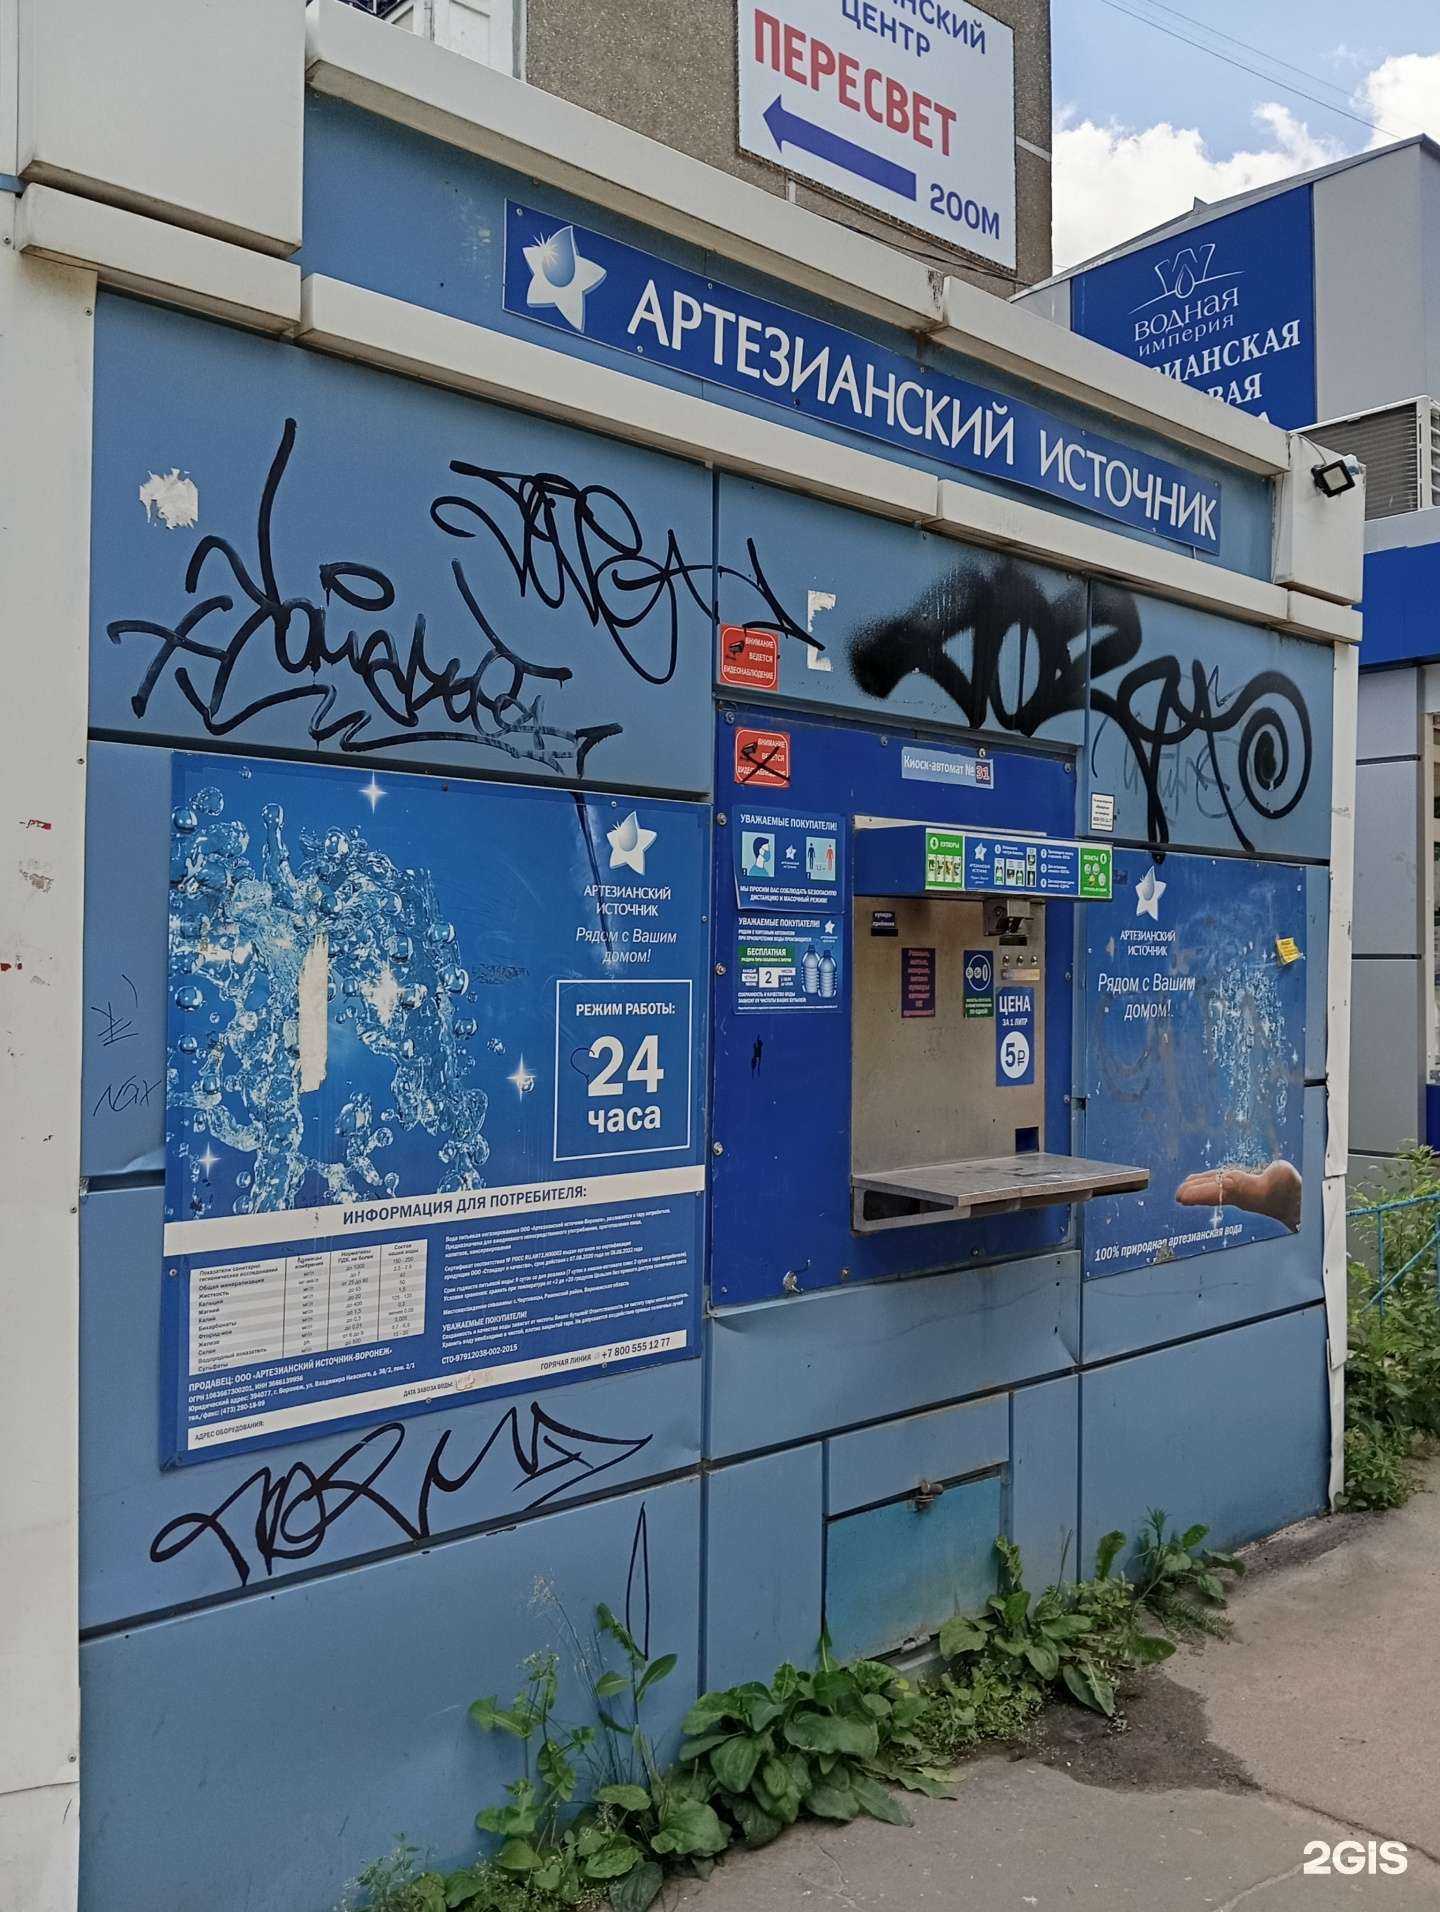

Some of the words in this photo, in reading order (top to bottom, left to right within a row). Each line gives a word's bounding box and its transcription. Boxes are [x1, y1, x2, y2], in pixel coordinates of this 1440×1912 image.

[842, 0, 930, 57] ЦЕНТР
[893, 0, 985, 54] НСКИЙ
[754, 8, 957, 157] ПЕРЕСВЕТ
[930, 183, 1000, 240] 200М
[1152, 319, 1301, 383] ИАНСКАЯ
[627, 278, 1016, 467] АРТЕЗИАНСКИЙ
[1039, 429, 1217, 541] ИСТОЧНИК
[745, 636, 774, 649] ВНИМАНИЕ
[749, 652, 773, 663] ВЕДЕТСЯ
[723, 664, 774, 680] ВИДЕОНАБЛЮДЕНИЕ
[904, 755, 964, 775] Киоск-автомат
[976, 765, 990, 780] 31
[740, 814, 789, 827] УВАЖАЕМЫЕ
[583, 884, 671, 900] АРТЕЗИАНСКИЙ
[596, 902, 658, 917] ИСТОЧНИК
[739, 917, 779, 926] УВАЖАЕМЫЕ
[576, 927, 619, 944] Рядом
[622, 932, 629, 943] с
[632, 927, 677, 944] Вашим
[1120, 930, 1176, 942] АРТЕЗИАНСКИЙ
[602, 949, 651, 964] домом!
[747, 948, 786, 956] БЕСПЛАТНАЯ
[1128, 946, 1168, 956] ИСТОЧНИК
[765, 971, 772, 984] 2
[1098, 973, 1139, 995] Рядом
[1142, 979, 1149, 991] с
[1153, 973, 1195, 992] Вашим
[575, 1002, 623, 1016] РЕЖИМ
[625, 1002, 676, 1016] РАБОТЫ:
[999, 995, 1031, 1015] ЦЕНА
[1124, 999, 1173, 1021] домом!
[1003, 1018, 1009, 1026] ЗА
[588, 1034, 664, 1097] 24
[588, 1104, 661, 1134] часа
[343, 1200, 453, 1225] ИНФОРМАЦИЯ
[456, 1196, 486, 1214] ДЛЯ
[490, 1185, 587, 1208] ПОТРЕБИТЕЛЯ:
[1095, 1246, 1119, 1262] 100%
[1168, 1228, 1223, 1248] артезианская
[1224, 1223, 1243, 1237] вода
[442, 1319, 485, 1331] УВАЖАЕМЫЕ
[485, 1310, 528, 1325] ПОКУПАТЕЛИ!
[601, 1348, 612, 1360] +7
[614, 1345, 630, 1357] 800
[631, 1341, 647, 1353] 555
[649, 1339, 659, 1350] 12
[660, 1337, 671, 1348] 77
[540, 1357, 569, 1371] ГОРЯЧАЯ
[569, 1353, 592, 1367] ЛИНИЯ
[189, 1376, 234, 1392] ПРОДАВЕЦ:
[235, 1371, 251, 1383] ООО
[403, 1388, 416, 1398] ДАТА
[195, 1431, 215, 1440] АДРЕС
